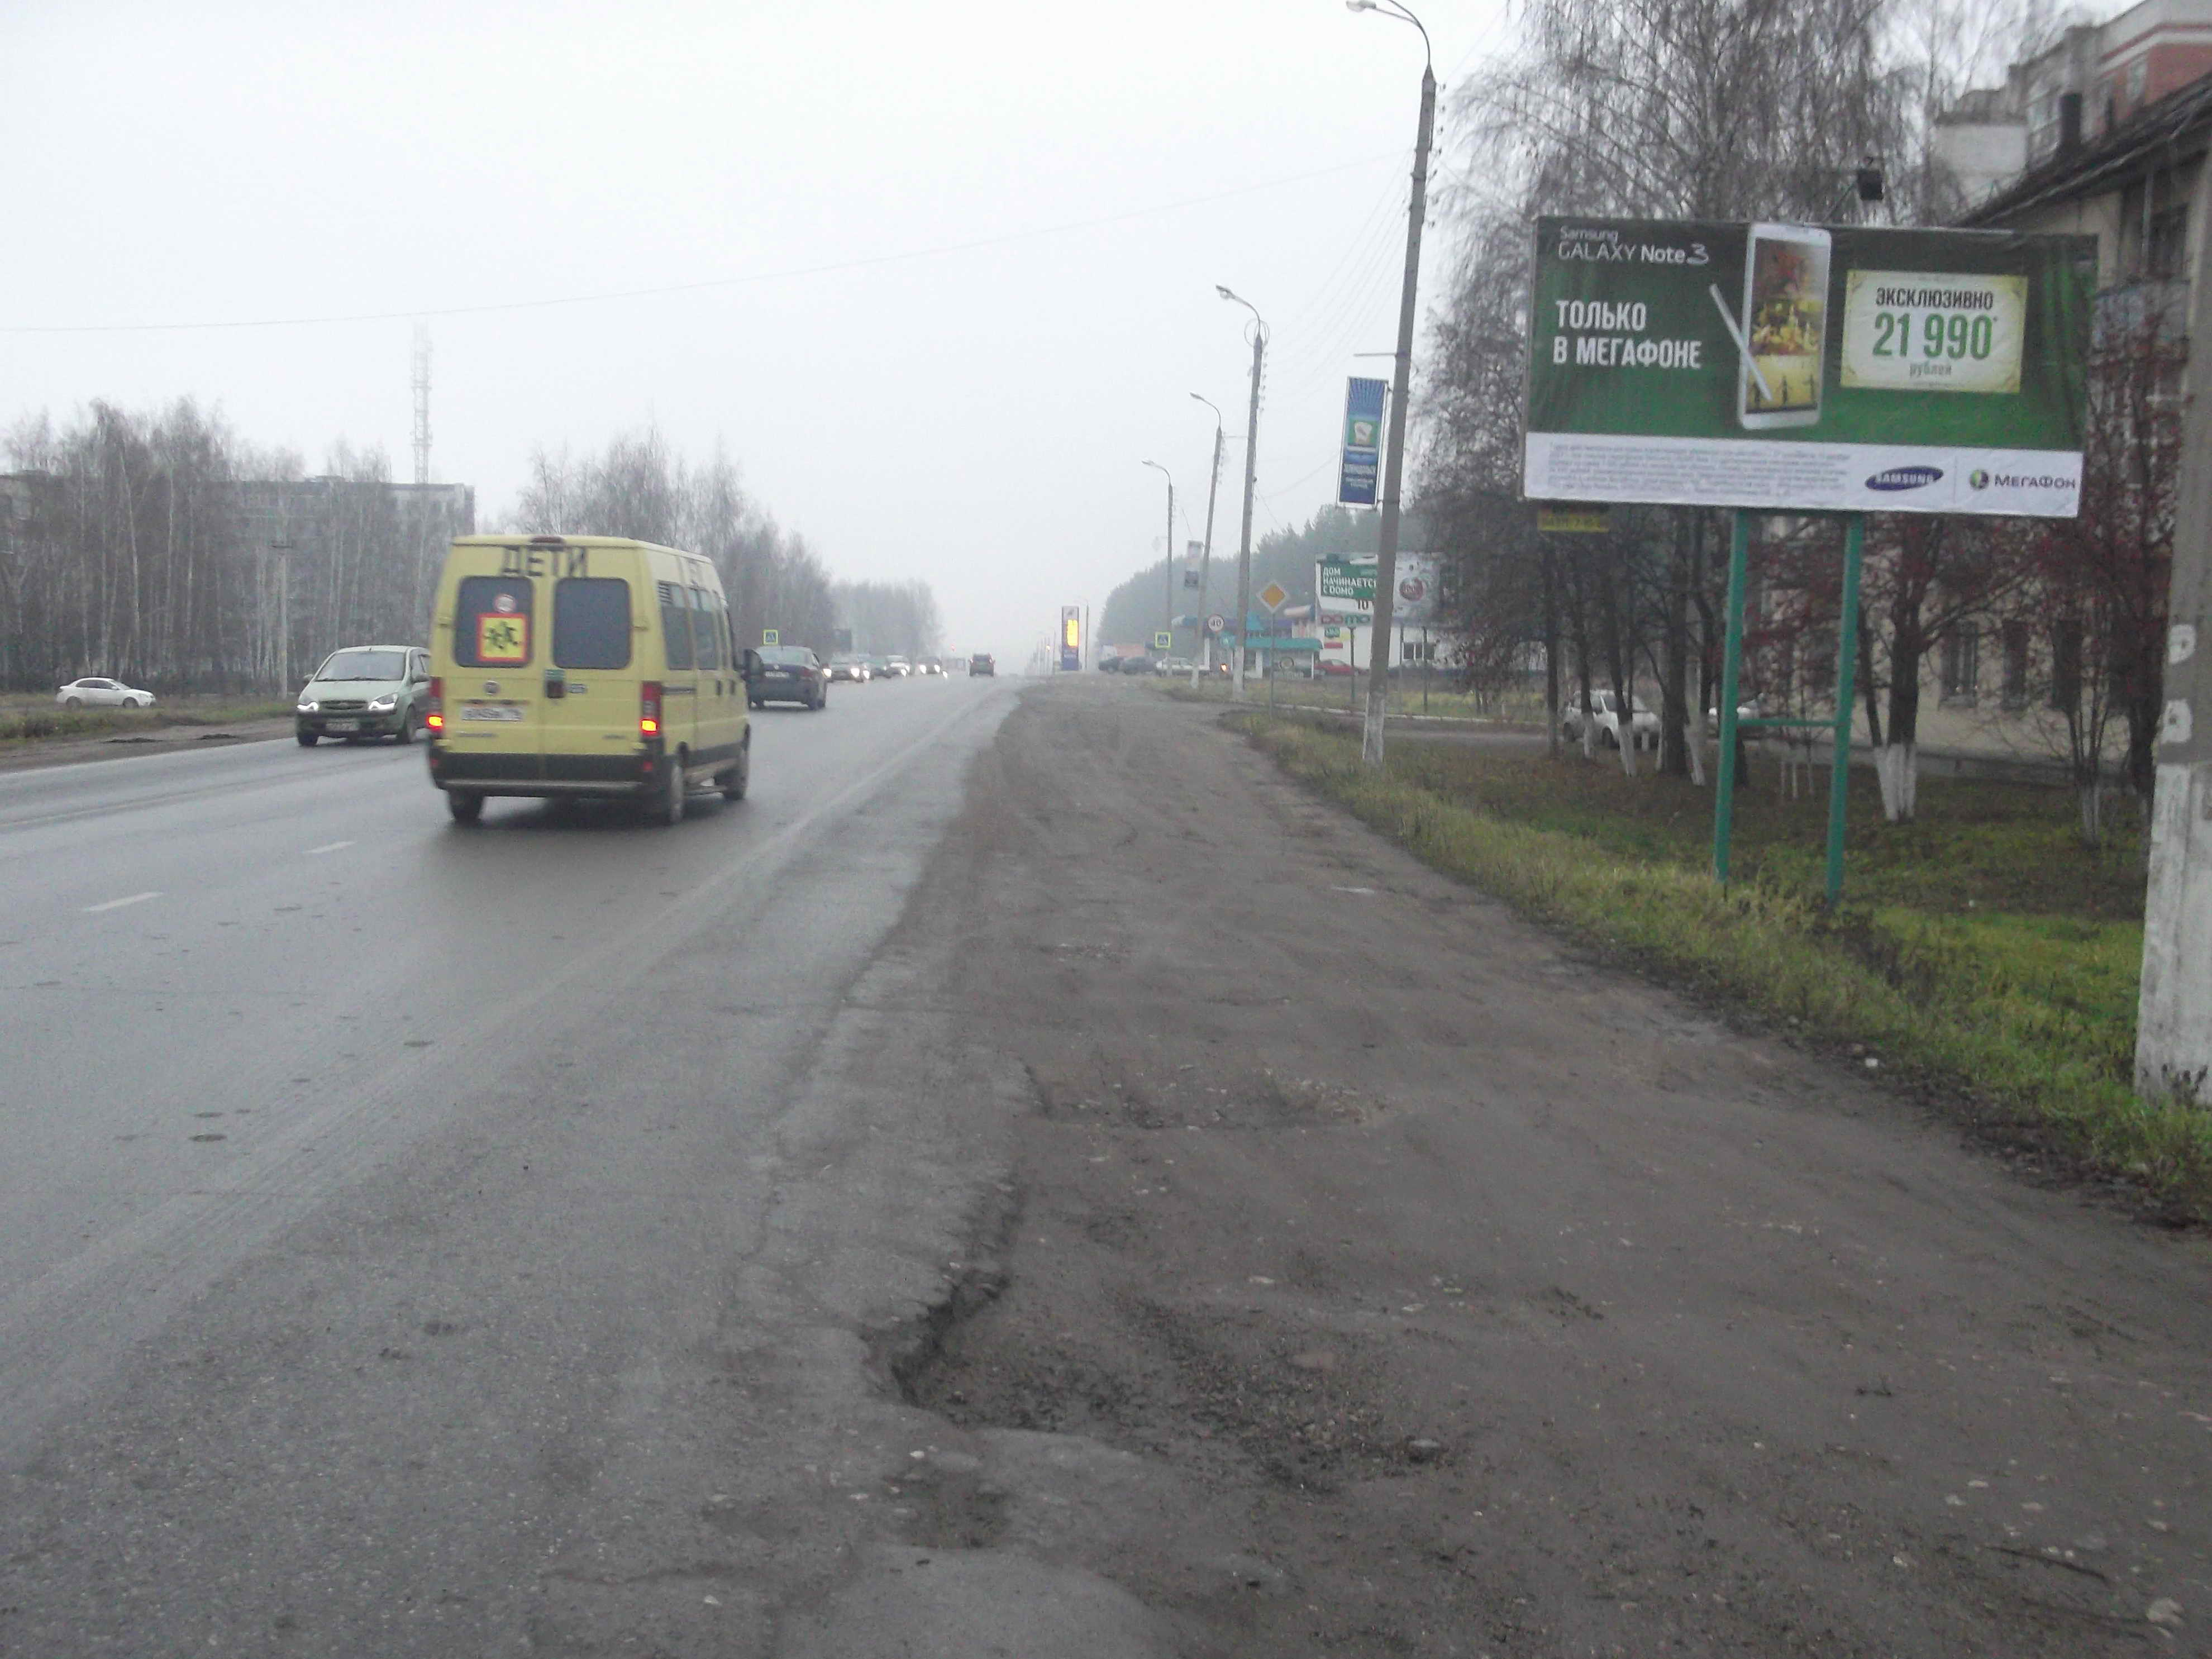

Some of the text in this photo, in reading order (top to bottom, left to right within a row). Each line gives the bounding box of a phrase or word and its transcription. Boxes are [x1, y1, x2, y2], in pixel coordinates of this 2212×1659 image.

[1558, 241, 1708, 265] GALAXY Note 3
[1875, 287, 1994, 310] ЭКСКЛЮЗИВНО
[1555, 300, 1646, 331] ТОЛЬКО
[1872, 312, 1910, 357] 21
[1553, 336, 1702, 369] В МЕГАФОНЕ
[1995, 474, 2076, 489] МЕГАФОН
[500, 545, 589, 578] ДЕТИ
[1323, 567, 1341, 576] ДОМ
